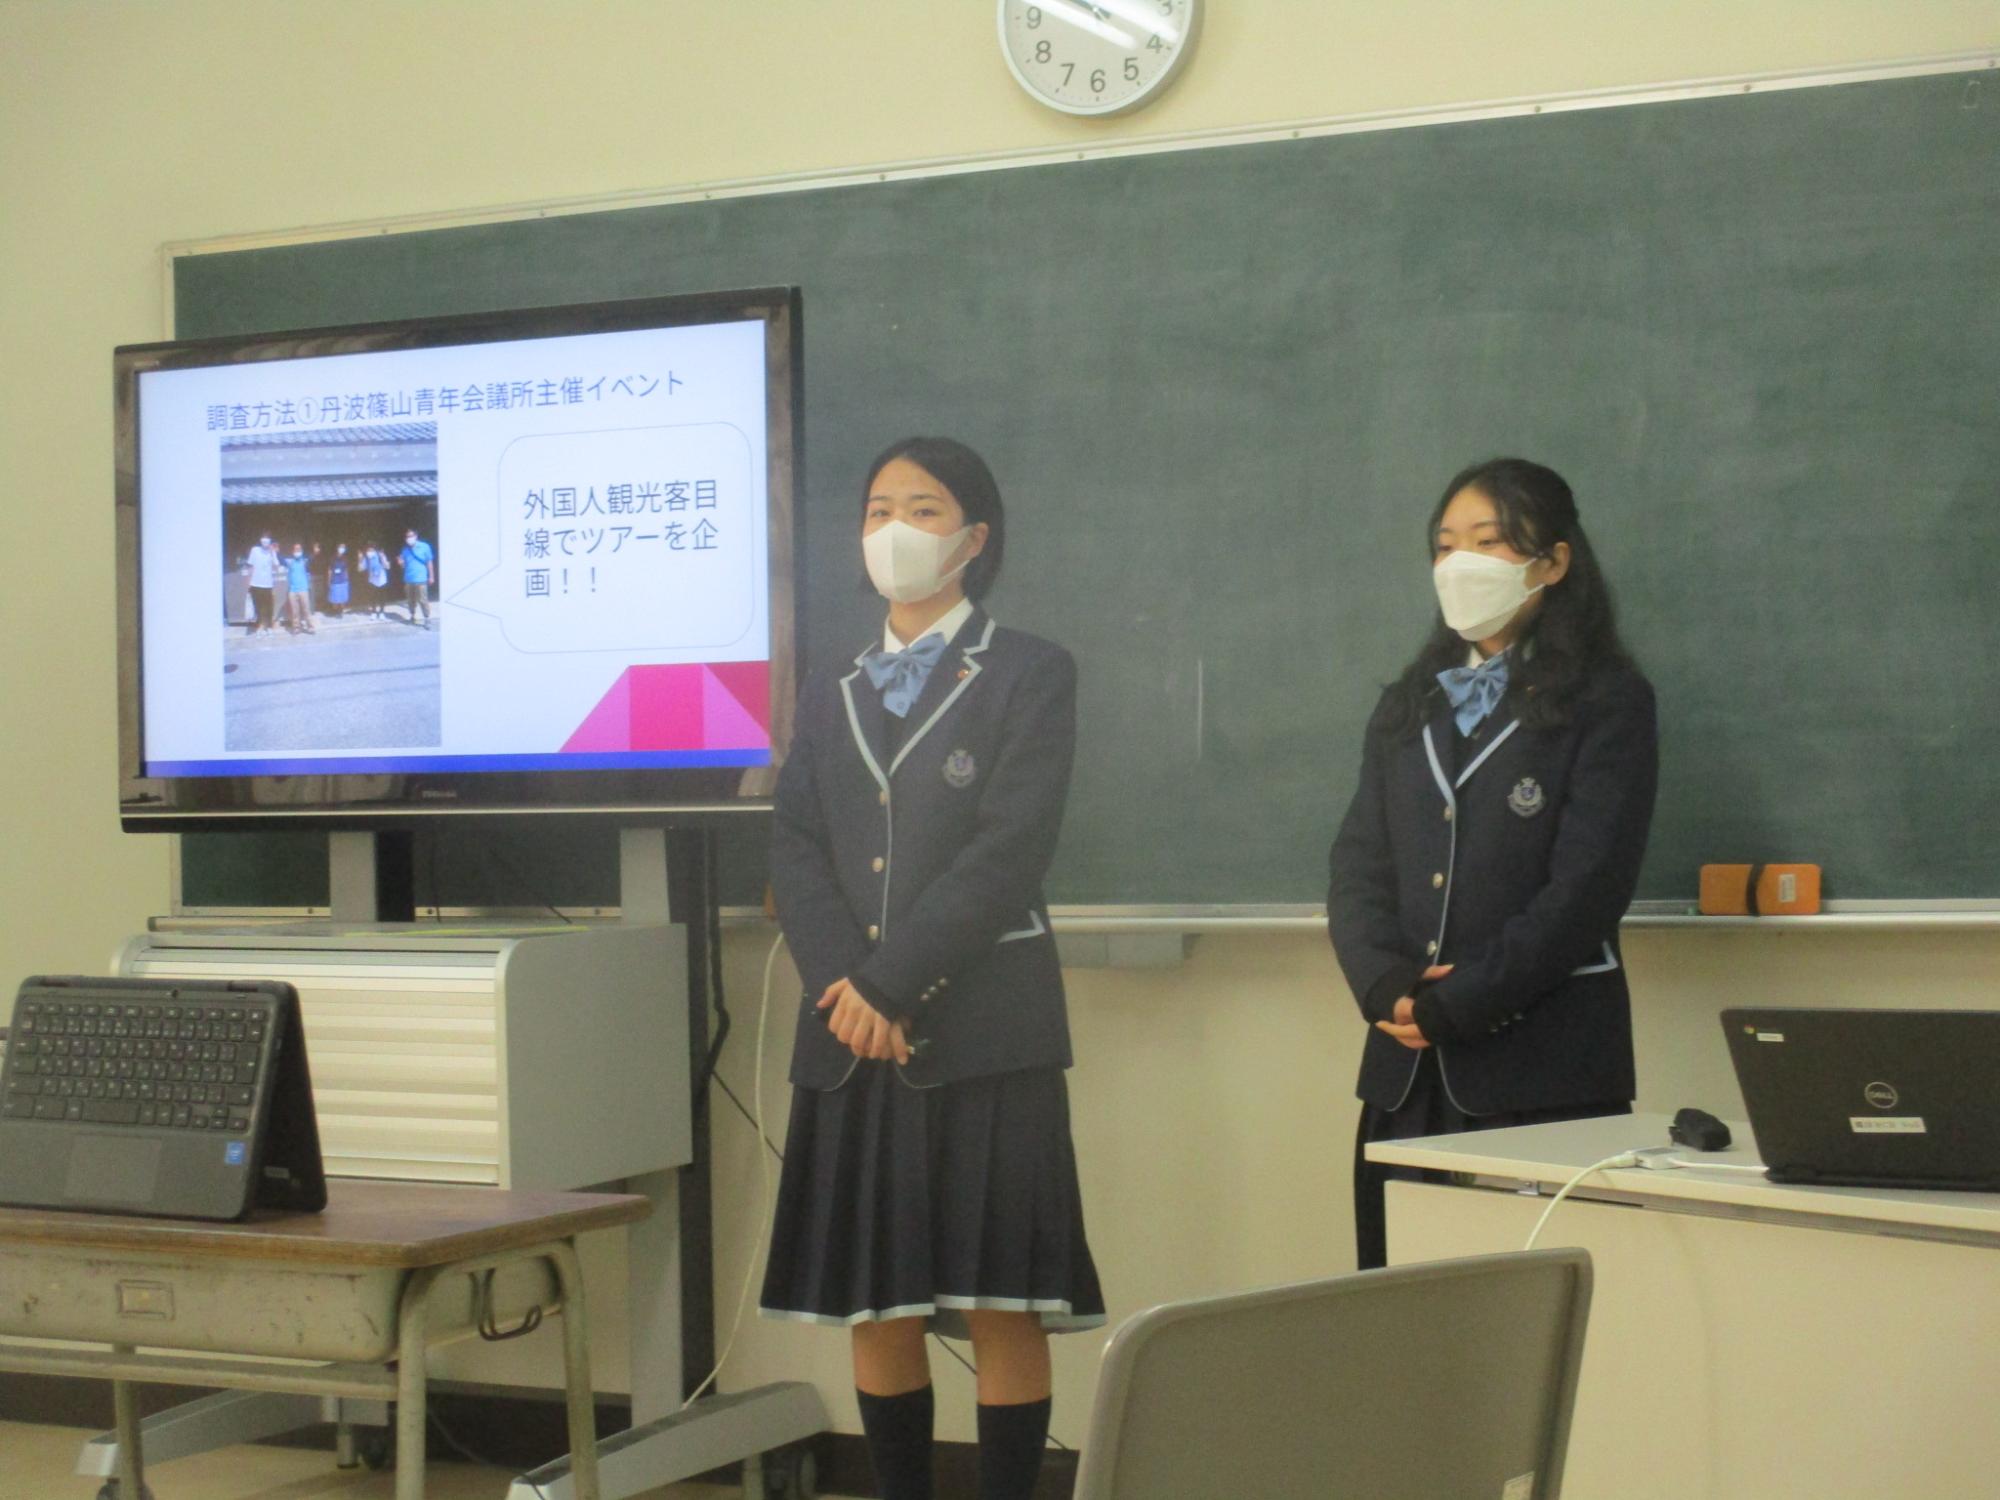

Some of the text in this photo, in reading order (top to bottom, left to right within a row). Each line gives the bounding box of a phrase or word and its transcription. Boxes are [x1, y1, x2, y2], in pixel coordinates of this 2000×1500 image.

[1026, 6, 1042, 29] 9
[1035, 40, 1051, 64] 8
[1145, 34, 1163, 54] 4
[1060, 63, 1075, 86] 7
[1124, 57, 1139, 81] 5
[1090, 70, 1106, 93] 6
[524, 479, 716, 520] 外国人観光客目
[524, 518, 719, 559] 線でツアーを企
[525, 567, 596, 598] 画！！
